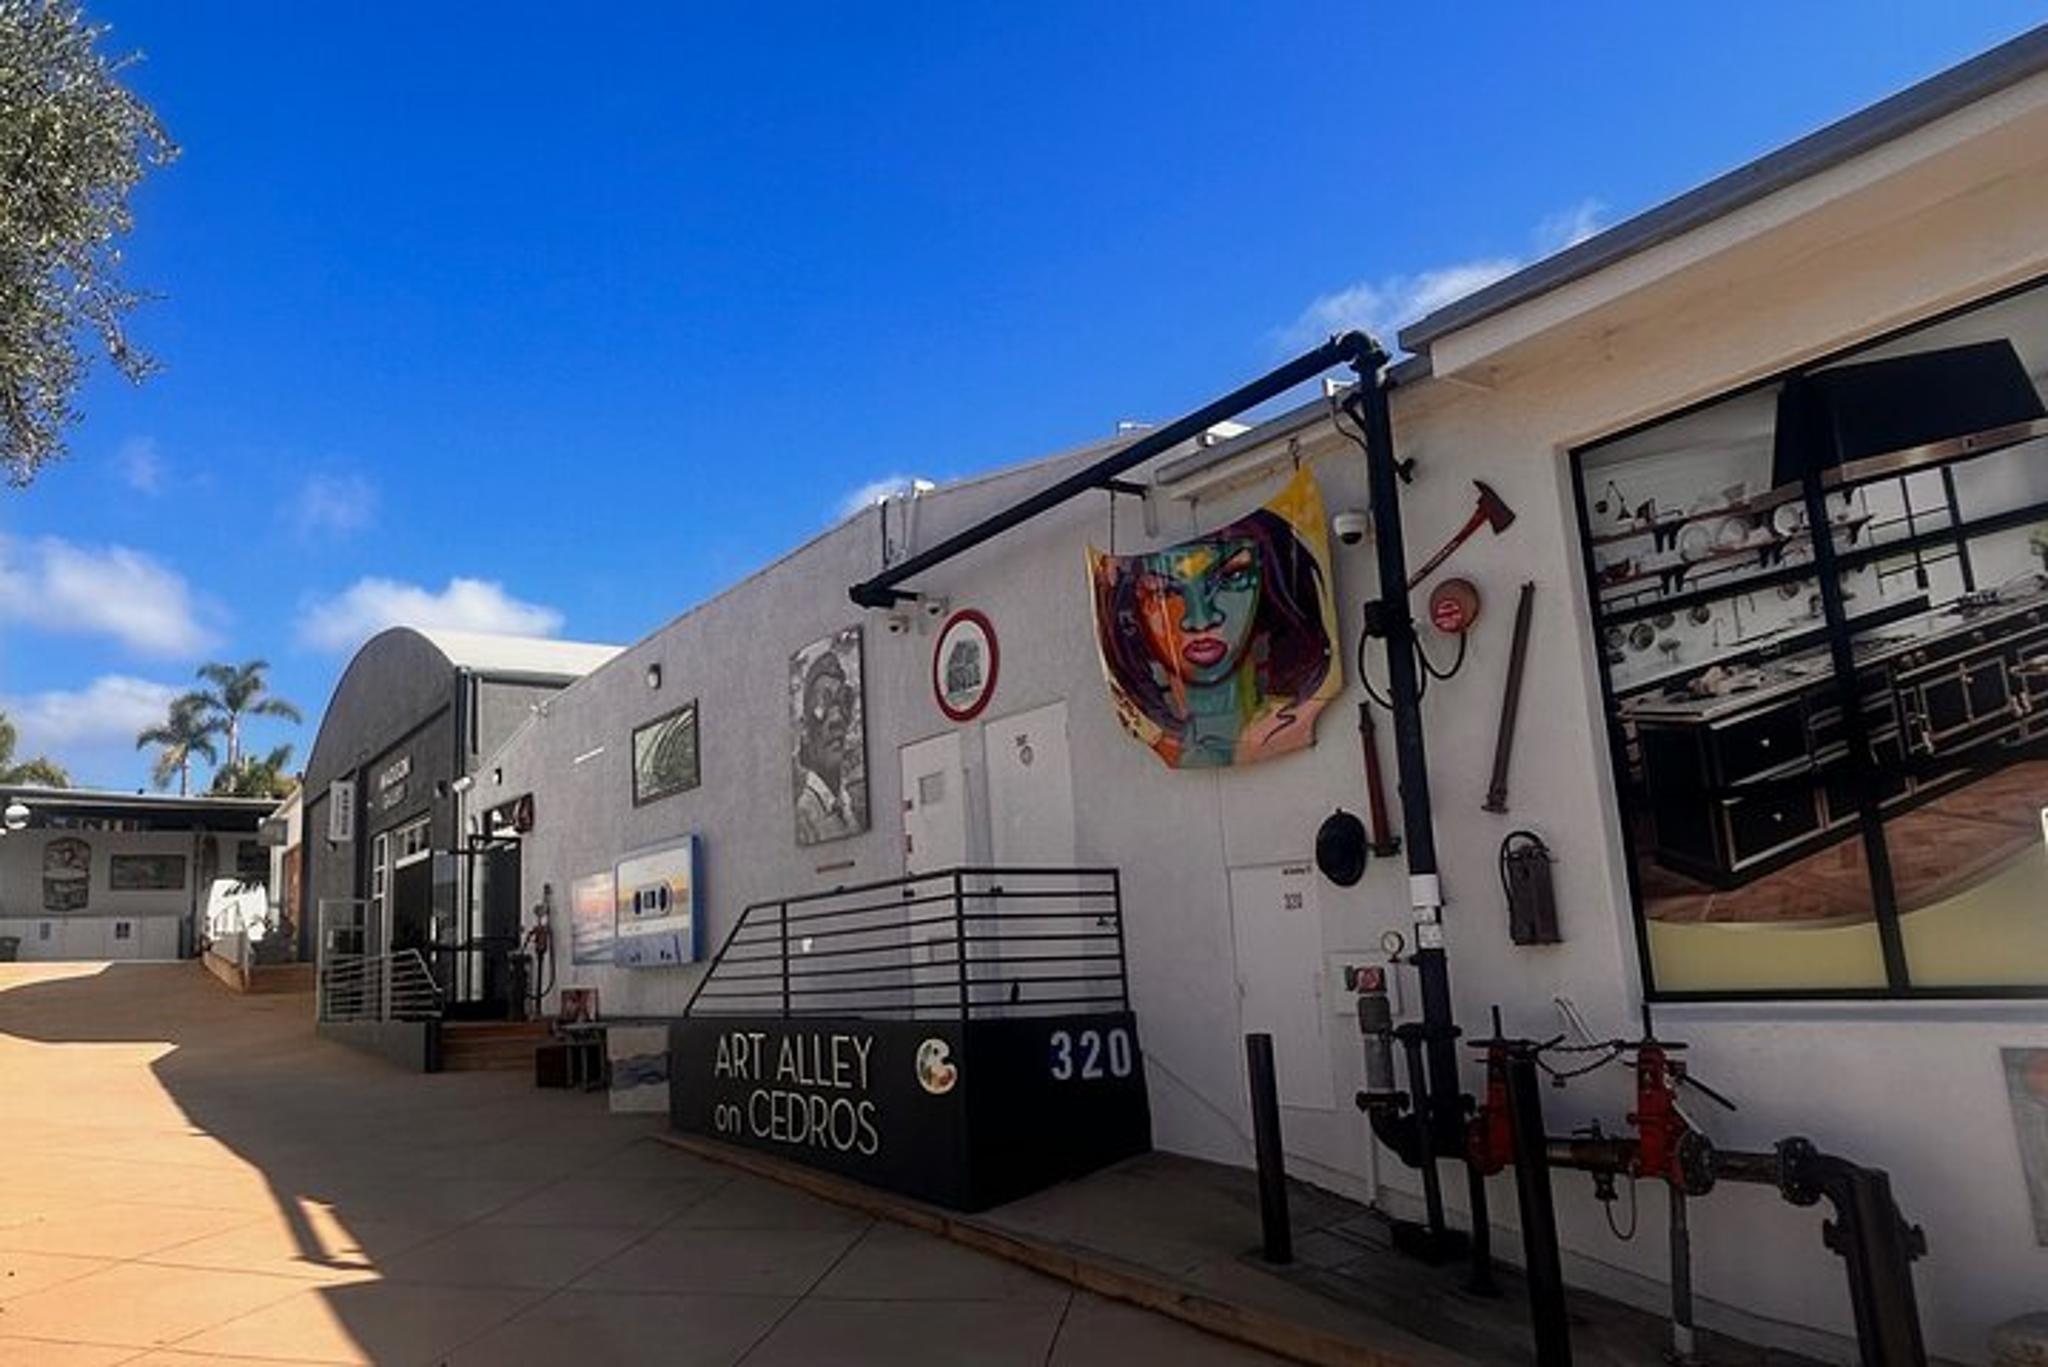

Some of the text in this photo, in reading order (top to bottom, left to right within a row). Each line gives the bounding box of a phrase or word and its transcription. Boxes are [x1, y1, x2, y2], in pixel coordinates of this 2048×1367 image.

[714, 1032, 873, 1090] ART ALLEY
[1050, 1028, 1132, 1080] 320
[714, 1088, 879, 1155] on CEDROS
